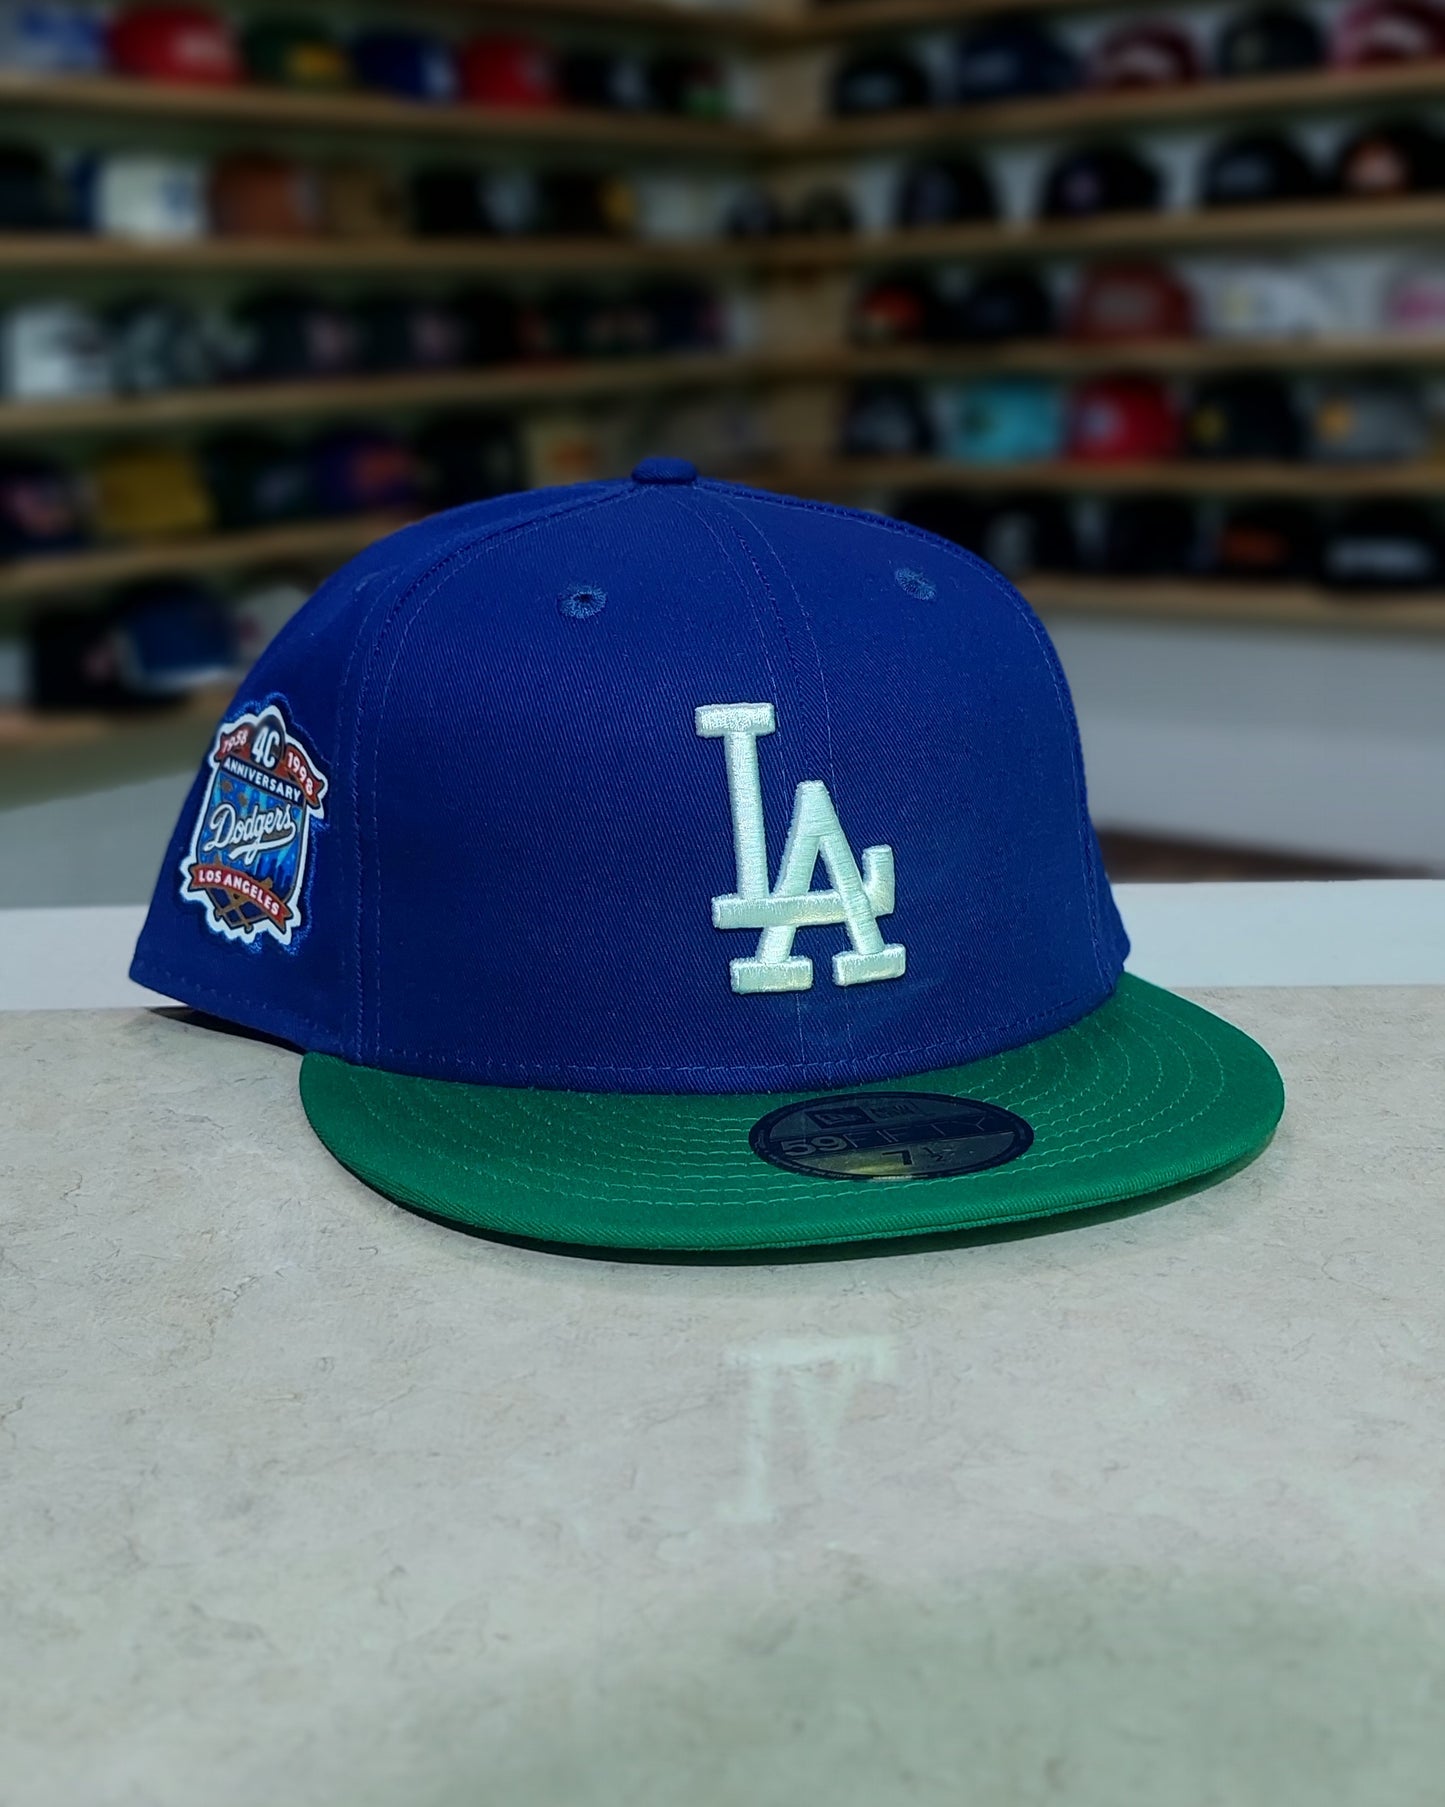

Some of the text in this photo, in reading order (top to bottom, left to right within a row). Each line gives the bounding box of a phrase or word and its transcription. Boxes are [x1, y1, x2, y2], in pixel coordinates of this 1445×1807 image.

[223, 757, 302, 803] ANNIVERSARY
[286, 752, 314, 797] 1998
[203, 803, 298, 866] Dodgers
[695, 702, 906, 994] LA
[198, 868, 280, 916] LOS ANGELES
